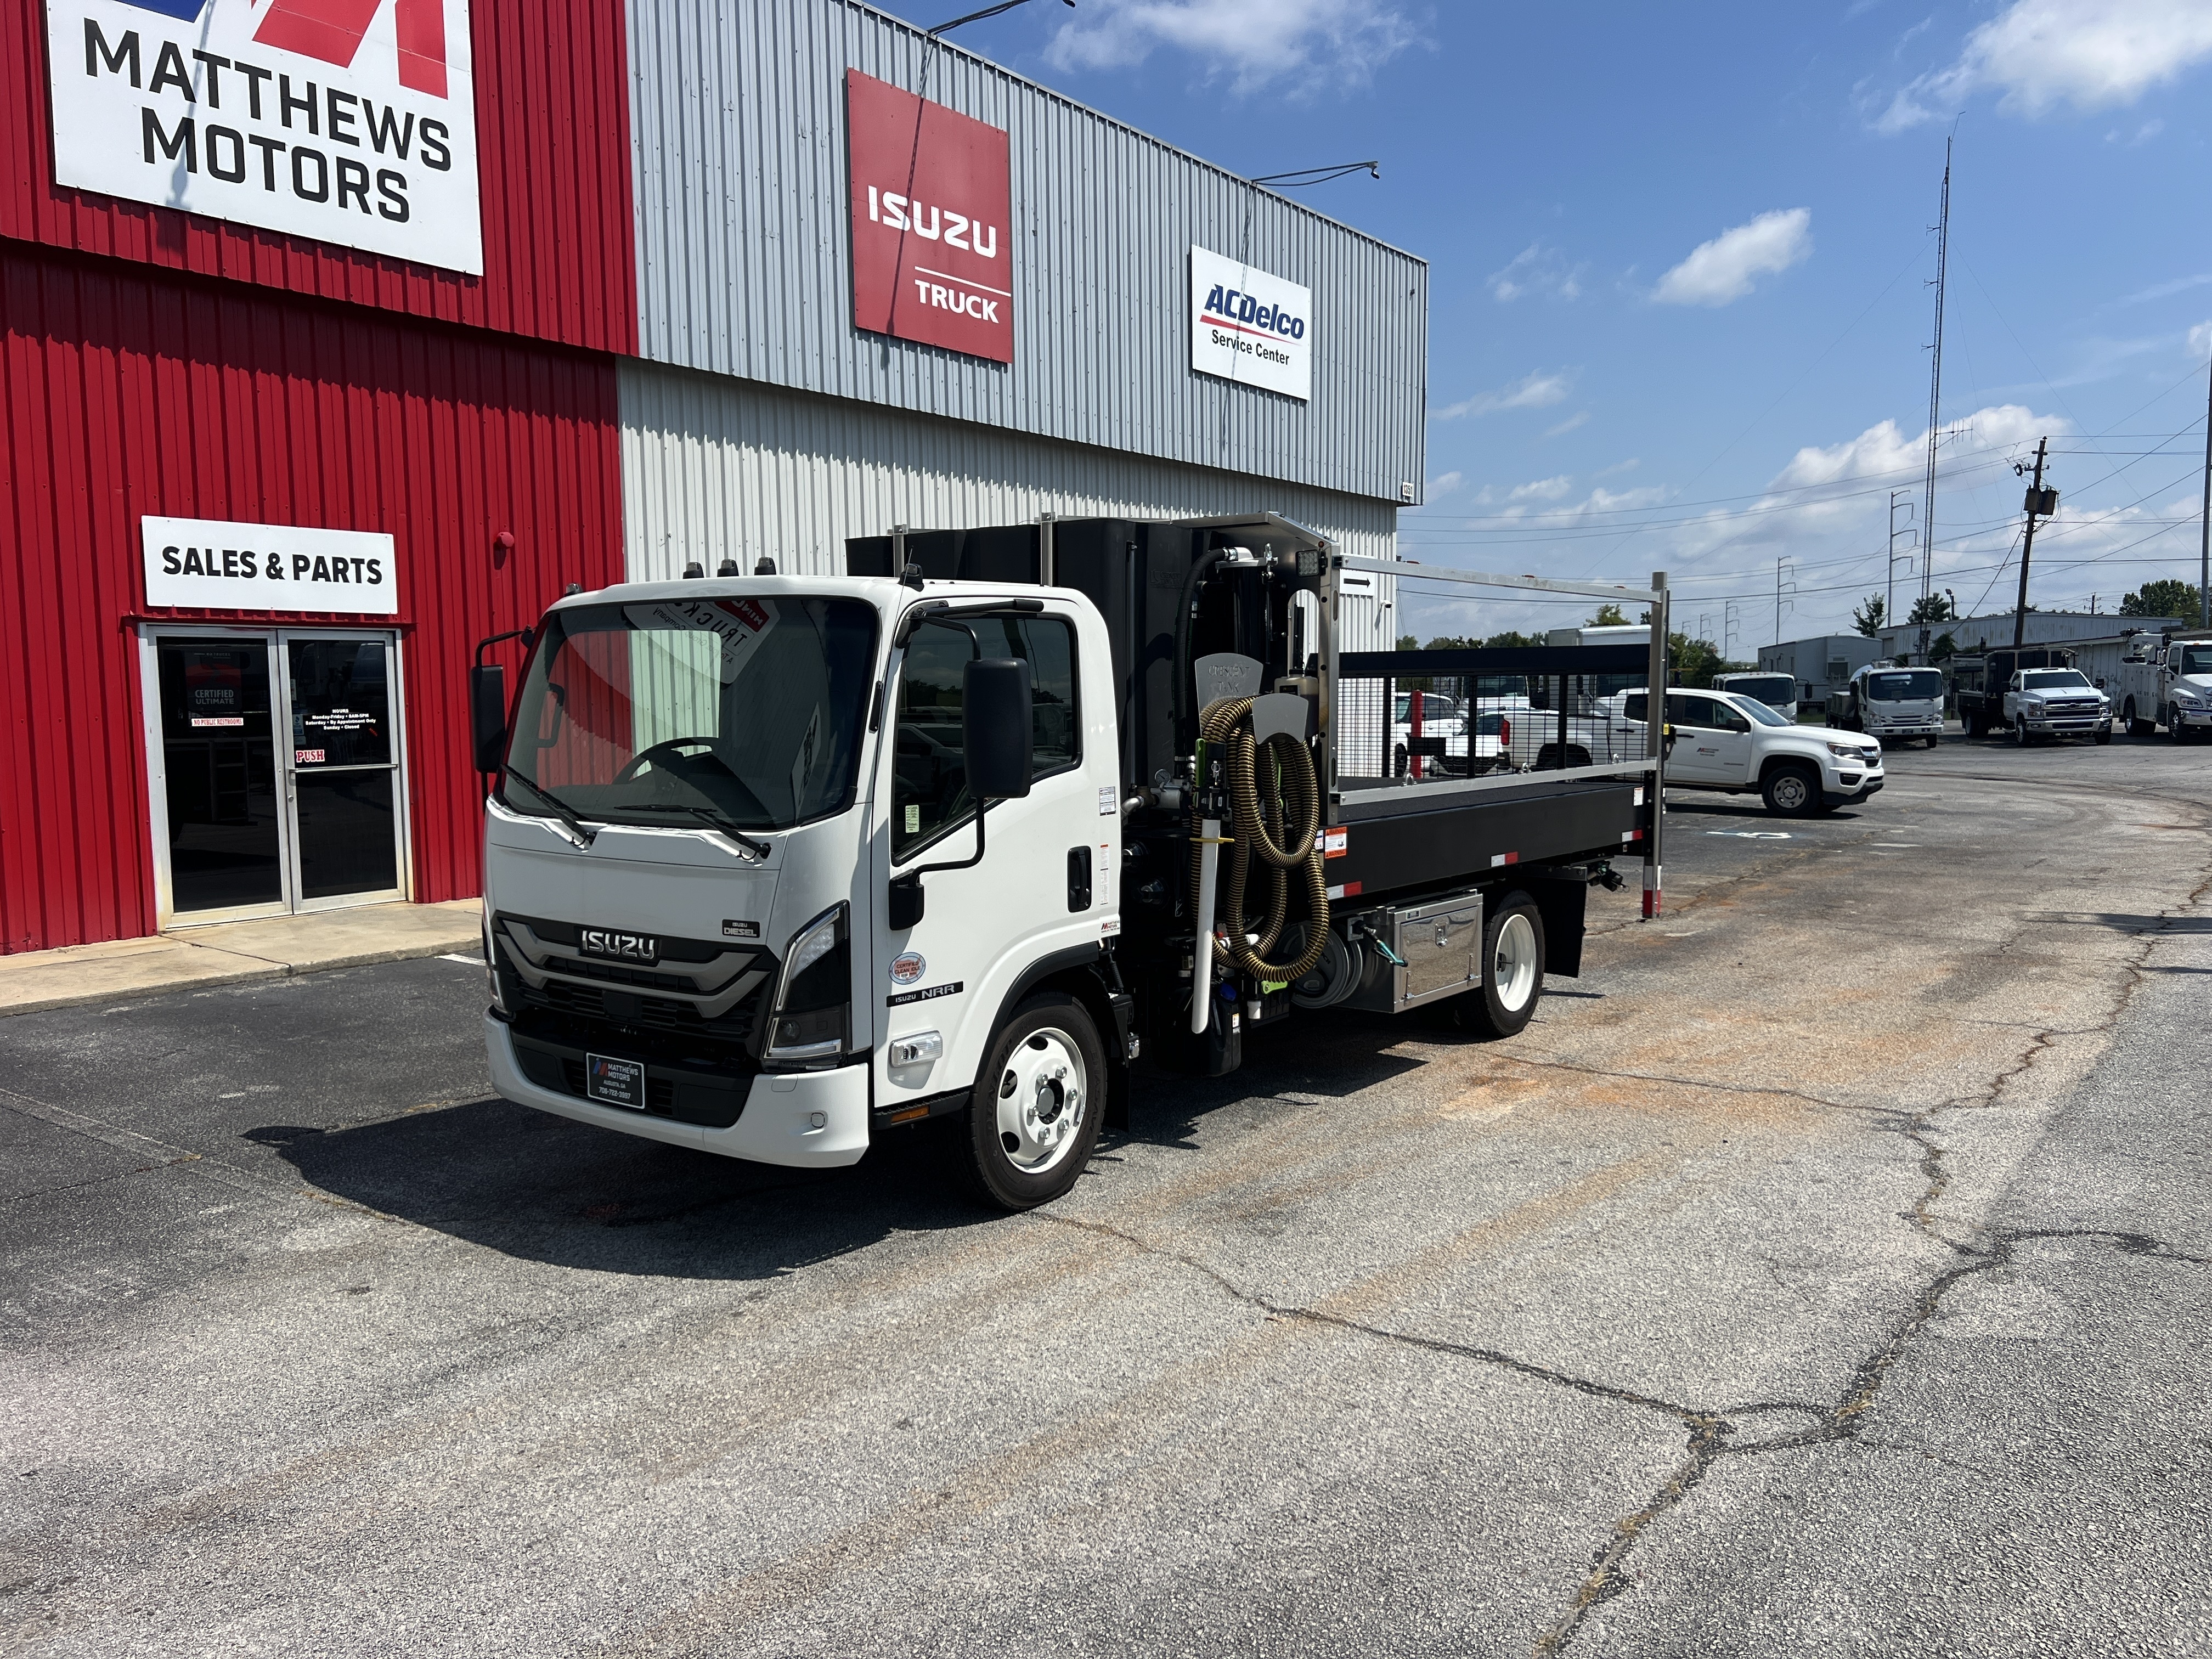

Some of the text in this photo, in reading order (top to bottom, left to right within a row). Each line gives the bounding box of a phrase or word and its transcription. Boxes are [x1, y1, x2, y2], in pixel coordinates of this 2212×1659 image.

[83, 17, 451, 171] MATTHEWS
[141, 106, 409, 223] MOTORS
[868, 185, 996, 258] ISUZU
[915, 279, 999, 324] TRUCK
[1204, 283, 1305, 340] ACDelco
[1211, 329, 1290, 365] Service Center
[161, 545, 383, 585] SALES & PARTS
[1208, 664, 1251, 678] CRESCENT
[195, 689, 234, 698] CERTIFIED
[1217, 681, 1239, 693] TANK
[296, 750, 324, 761] PUSH
[724, 927, 757, 936] DIESEL
[582, 930, 654, 960] ISUZU
[895, 985, 955, 1003] ISUZU NRR
[608, 1063, 639, 1075] MATTHEWS
[608, 1070, 630, 1081] MOTORS
